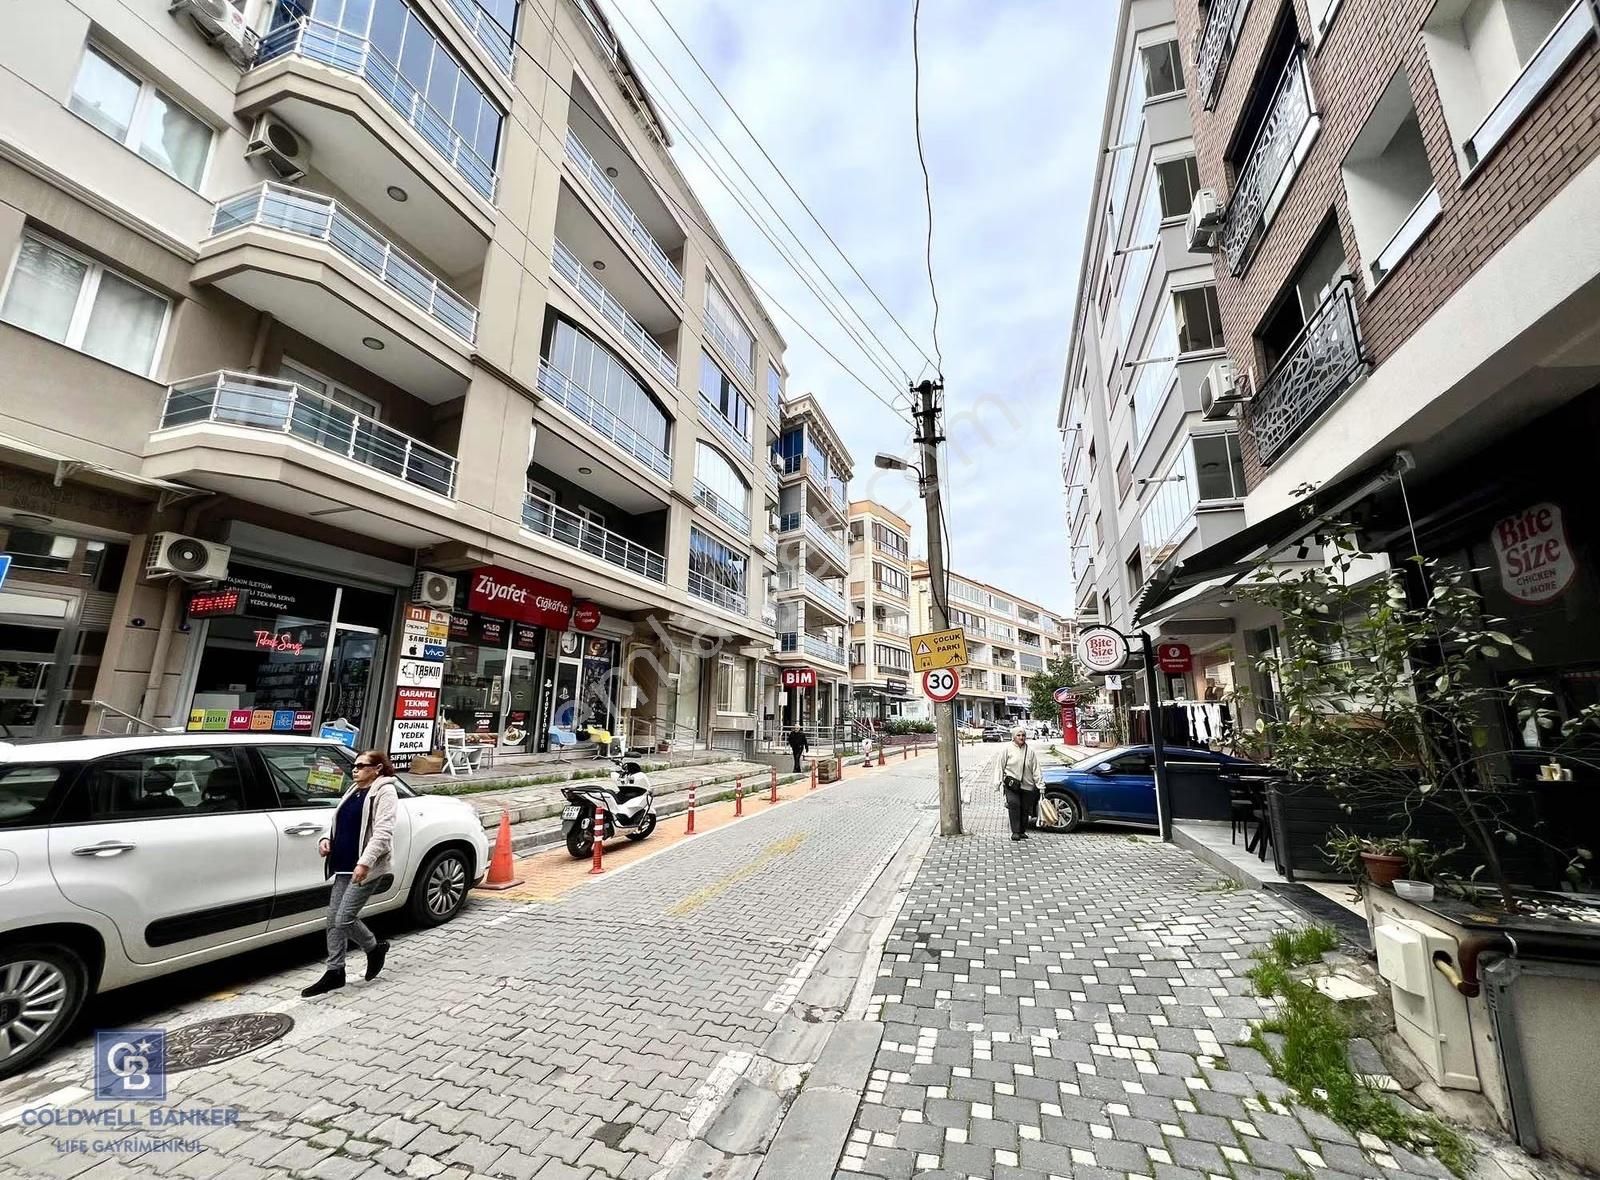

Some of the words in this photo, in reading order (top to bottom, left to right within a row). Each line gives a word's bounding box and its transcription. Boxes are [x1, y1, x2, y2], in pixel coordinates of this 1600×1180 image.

[1497, 508, 1553, 550] Bite
[1506, 539, 1561, 578] Size
[1516, 568, 1557, 586] CHICKEN
[475, 574, 528, 604] Ziyafet
[1530, 581, 1558, 595] MORE
[250, 599, 268, 607] YEDEK
[408, 635, 443, 645] SAMSUNG
[933, 633, 961, 645] ÇOCUK
[1090, 638, 1112, 649] Bite
[424, 648, 445, 657] vivo
[936, 643, 961, 653] PARKI
[1091, 647, 1113, 658] Size
[929, 673, 953, 690] 30
[399, 741, 424, 750] PARÇA
